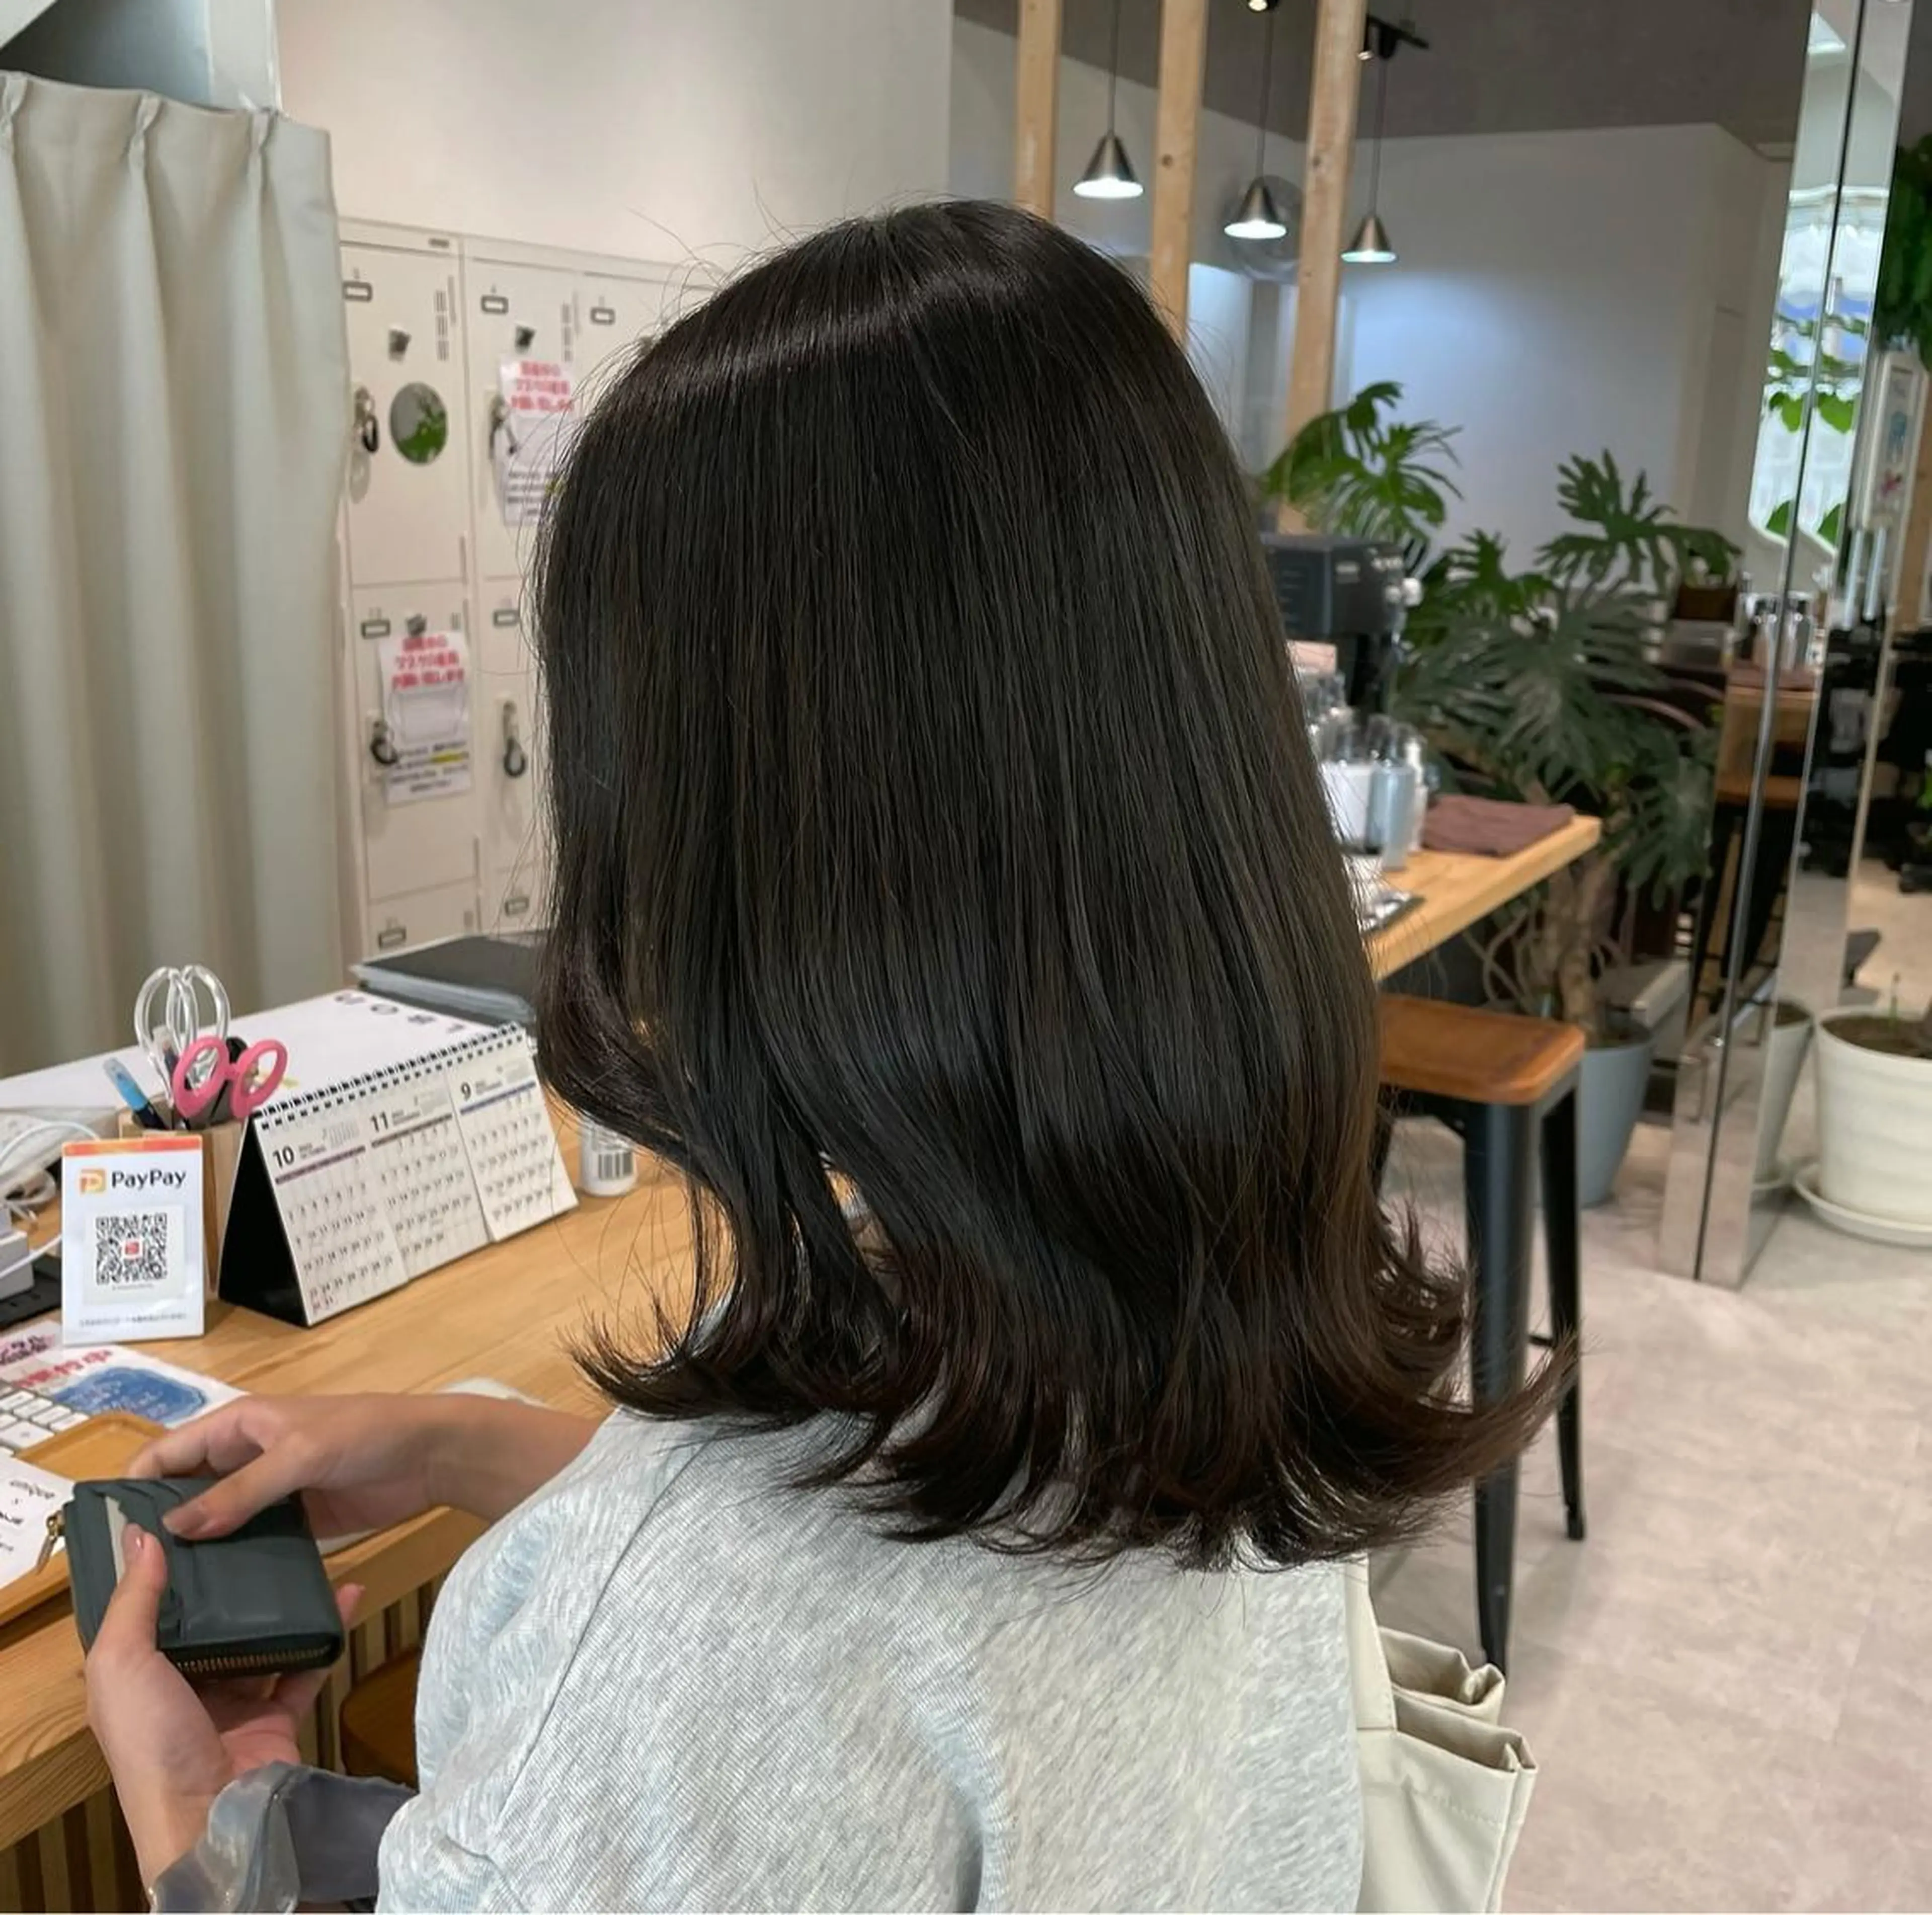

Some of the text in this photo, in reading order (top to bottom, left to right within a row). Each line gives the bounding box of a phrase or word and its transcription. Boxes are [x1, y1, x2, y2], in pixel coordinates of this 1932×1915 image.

[461, 1082, 471, 1101] 9
[371, 1111, 388, 1132] 11
[273, 1146, 295, 1169] 10
[111, 1169, 187, 1190] PayPay
